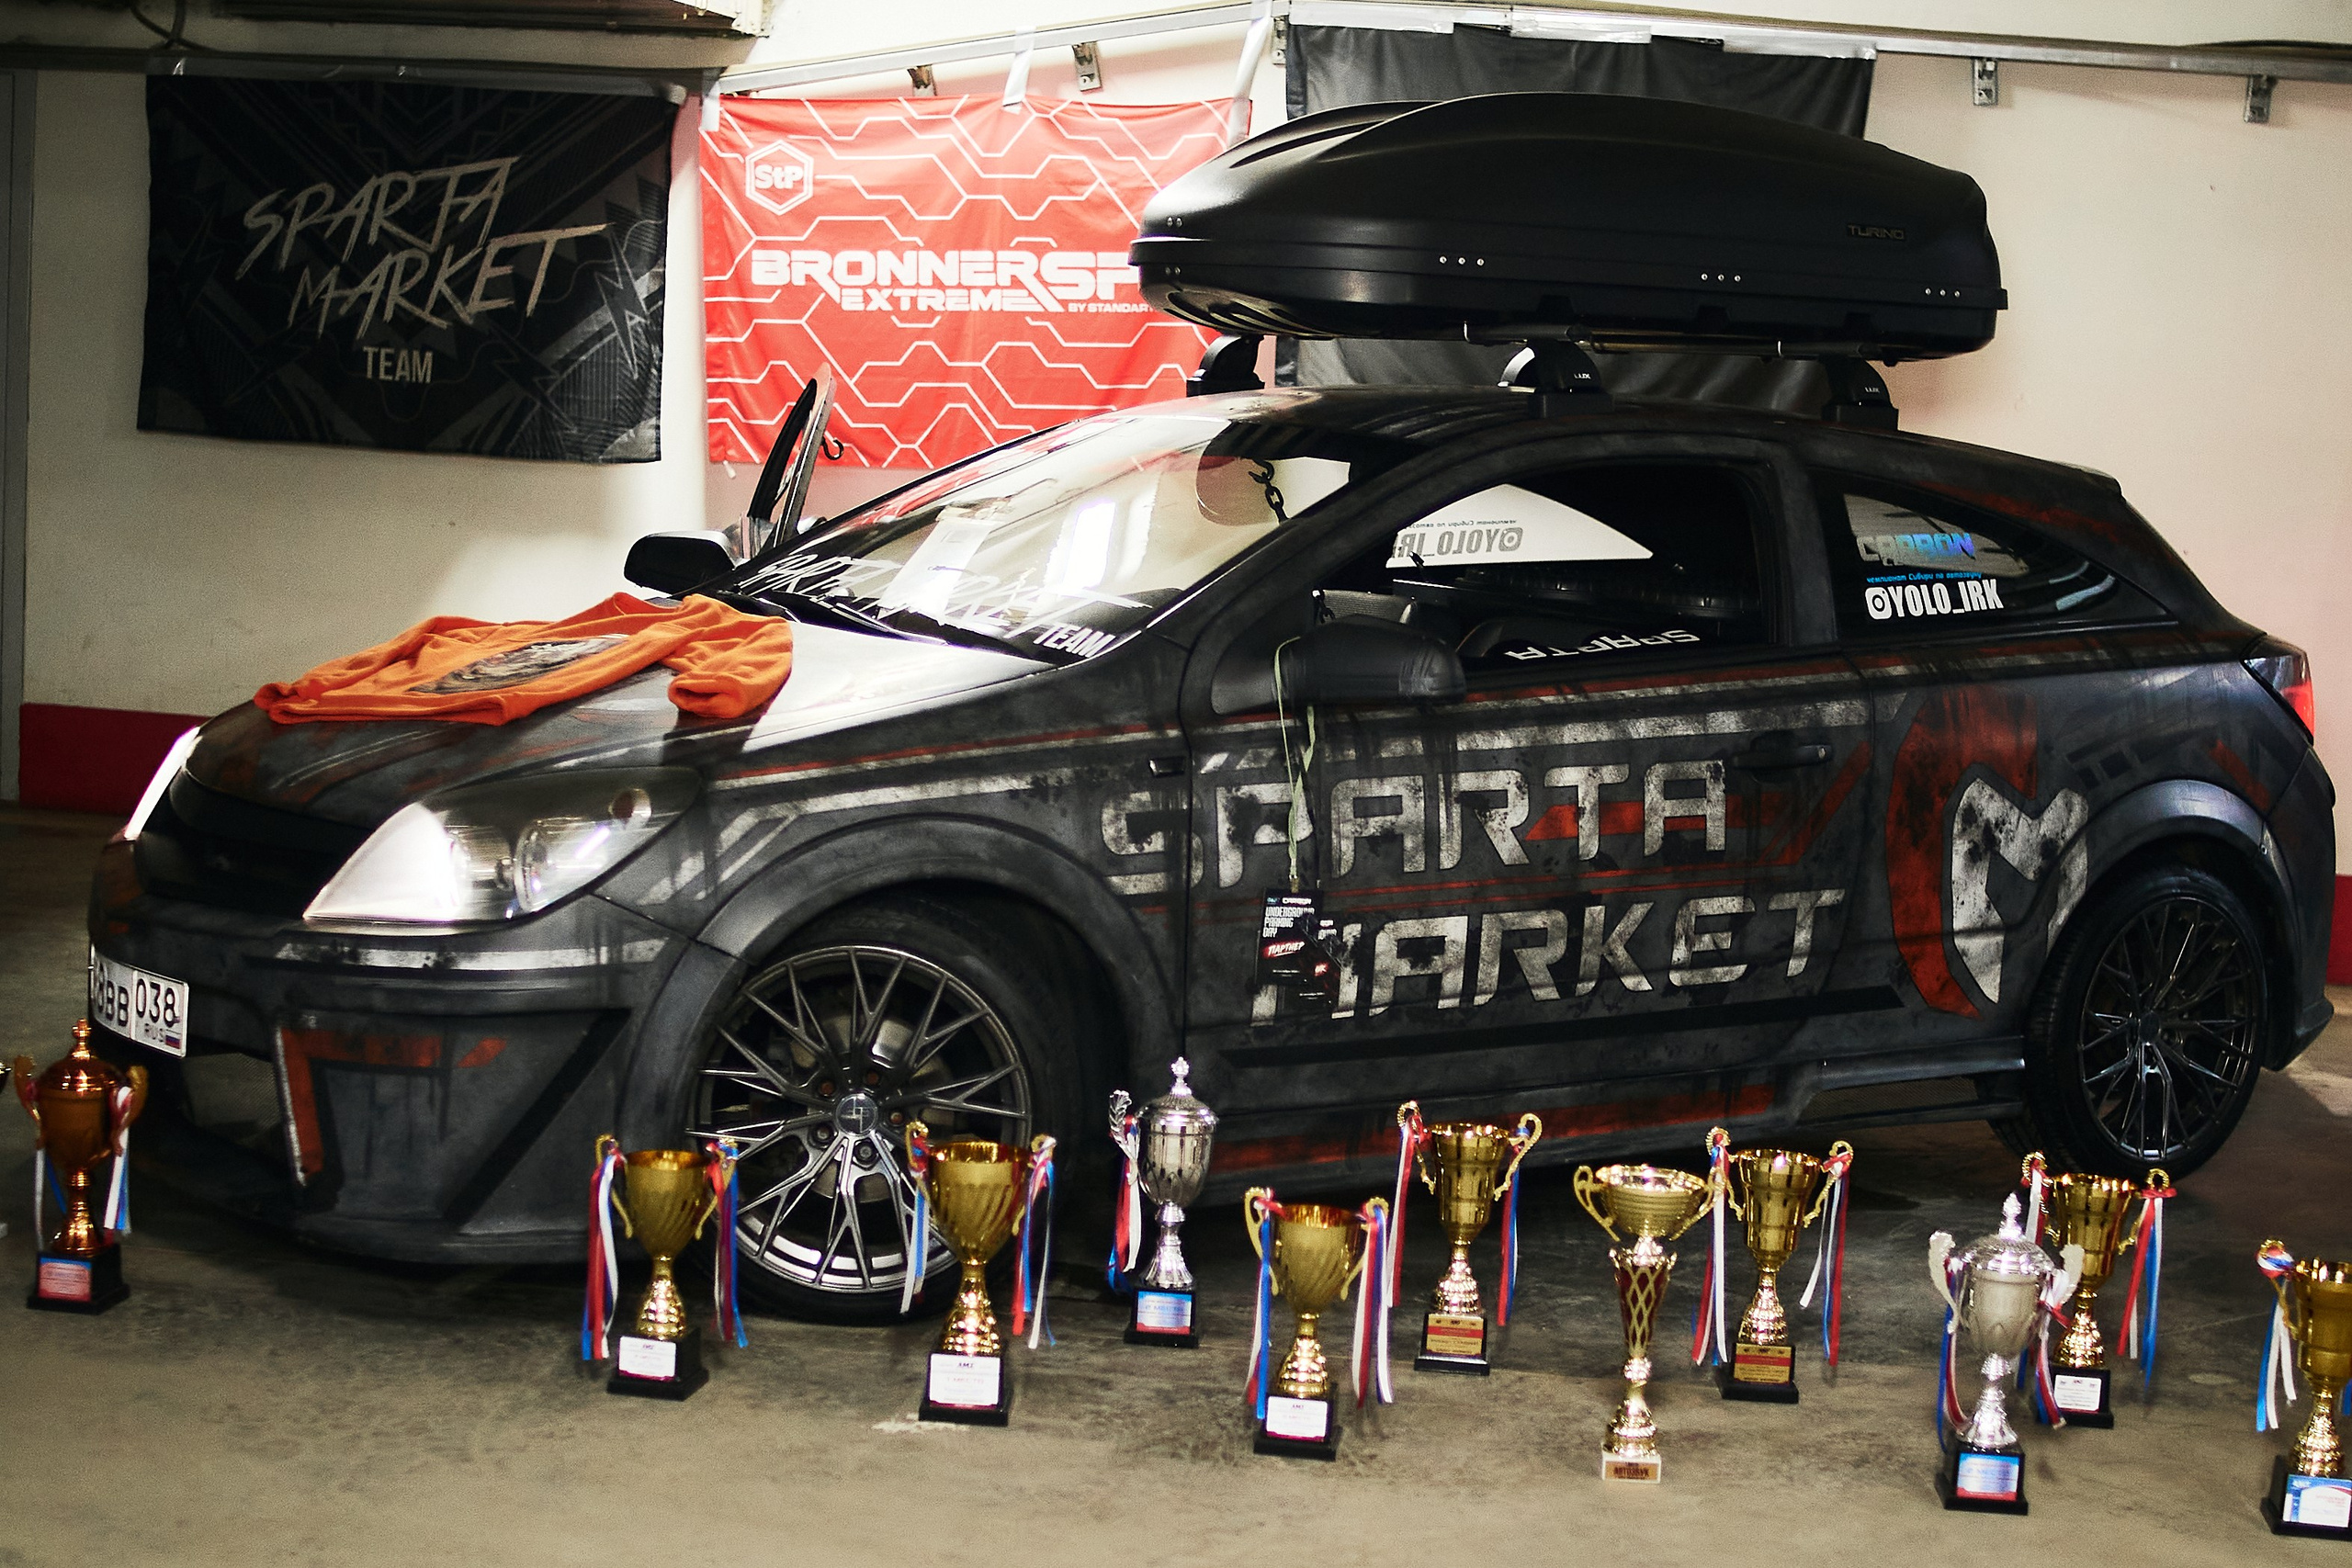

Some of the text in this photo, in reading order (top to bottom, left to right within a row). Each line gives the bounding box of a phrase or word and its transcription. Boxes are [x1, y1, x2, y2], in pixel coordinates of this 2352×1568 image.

[754, 164, 804, 189] StP
[235, 156, 521, 280] SPARTA
[288, 223, 616, 339] MARKET
[841, 288, 1045, 311] EXTREME
[1068, 302, 1154, 313] BY STANDAR
[363, 346, 433, 384] TEAM
[1033, 623, 1116, 659] TEAM
[1102, 760, 1725, 897] SPARTA
[1262, 927, 1278, 938] DAY
[1268, 941, 1306, 956] ПАРТНЕР
[135, 977, 175, 1028] 038
